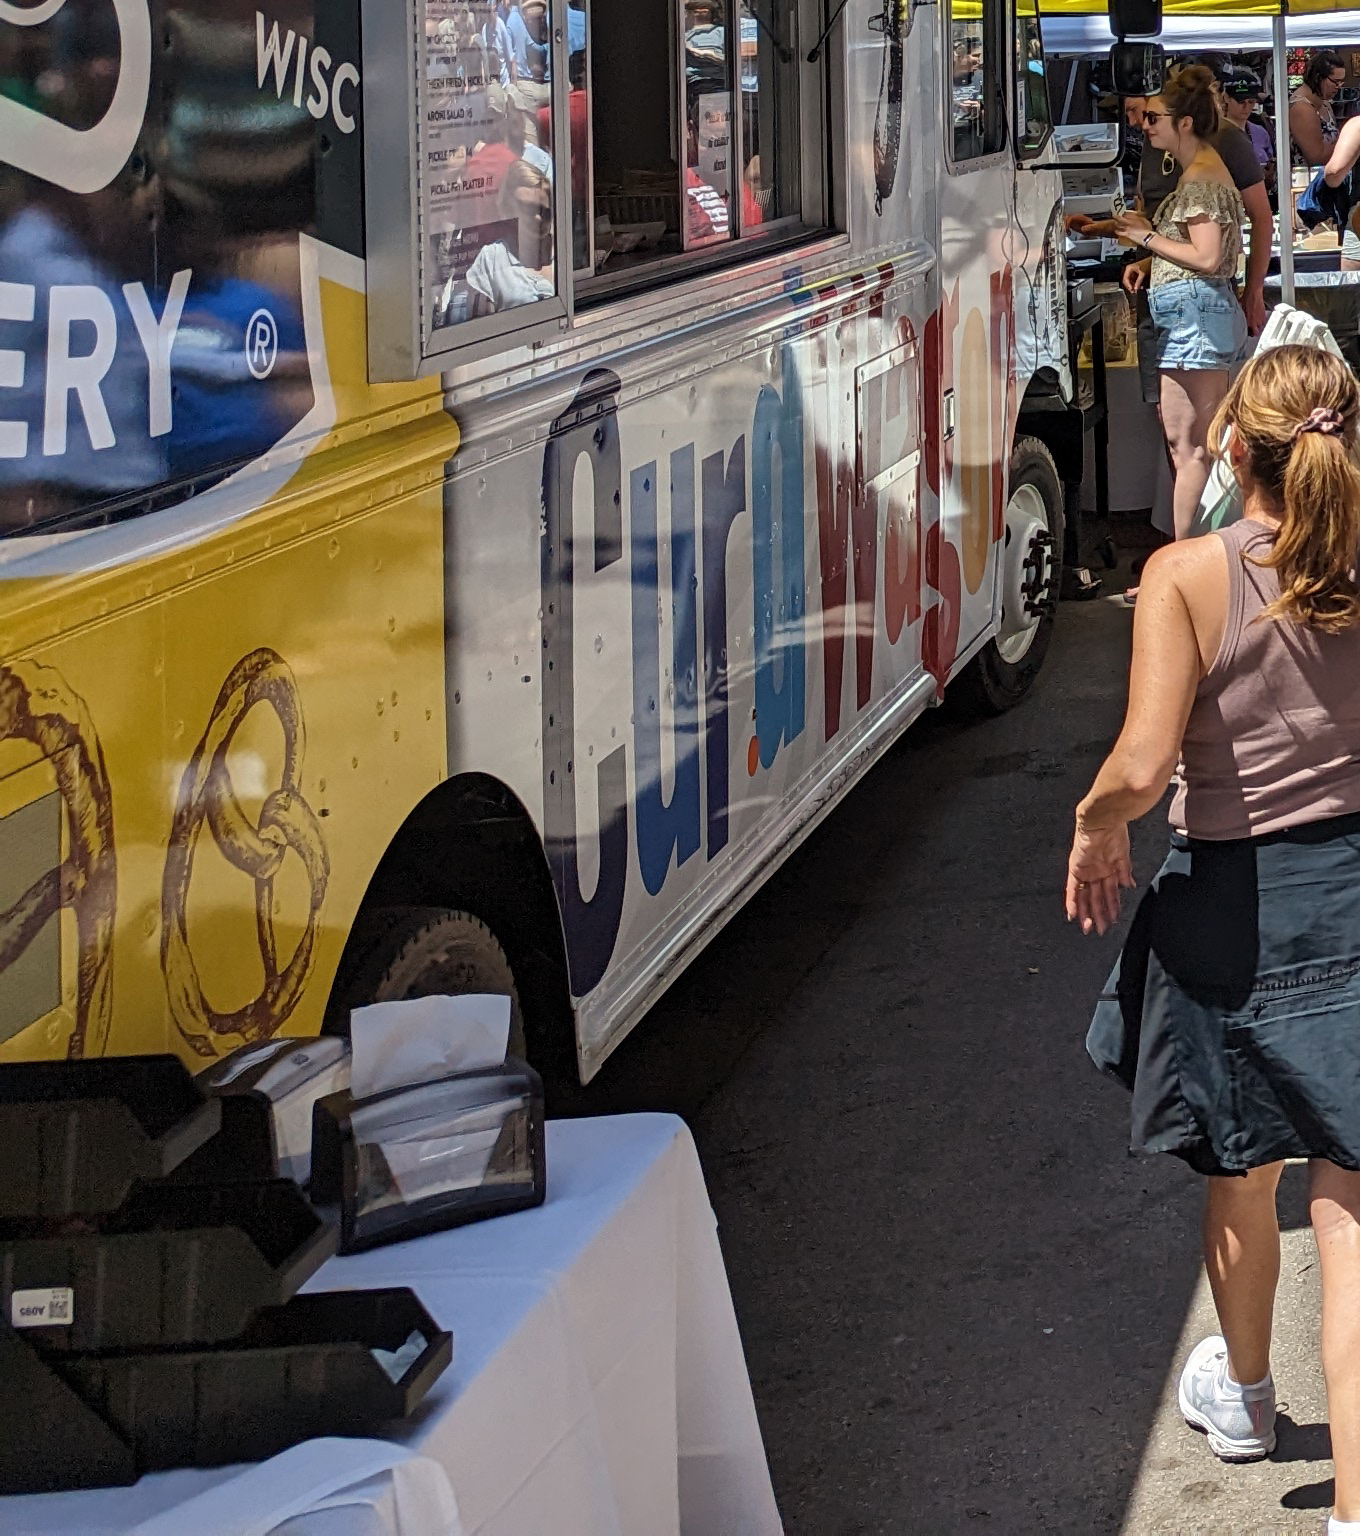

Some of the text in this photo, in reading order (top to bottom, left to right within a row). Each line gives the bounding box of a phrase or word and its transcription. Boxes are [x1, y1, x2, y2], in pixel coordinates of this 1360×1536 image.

[255, 10, 360, 134] WISC
[541, 261, 1018, 998] Curd Wagon
